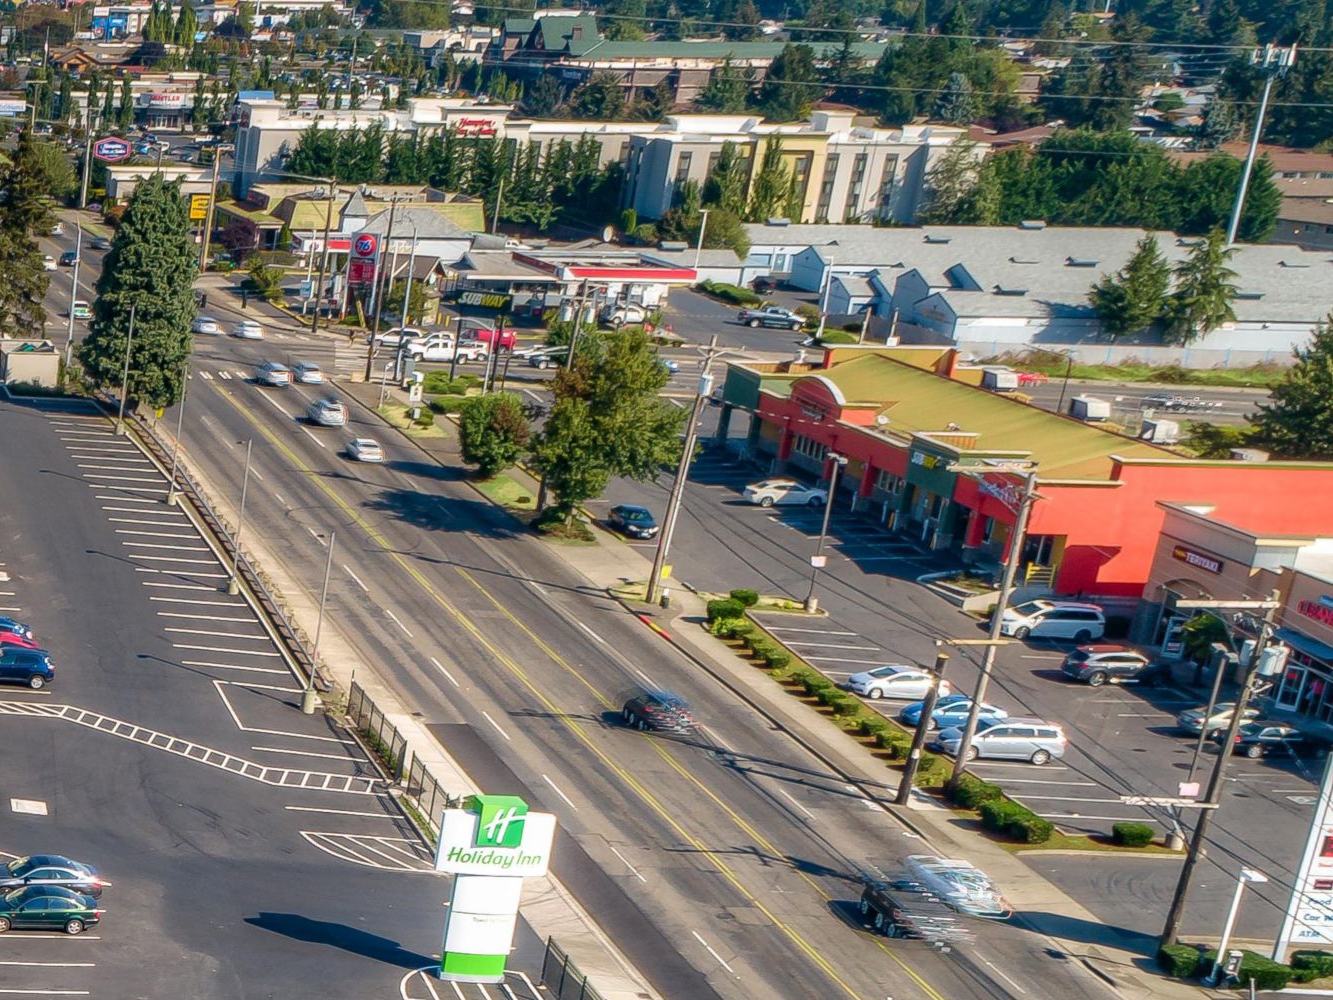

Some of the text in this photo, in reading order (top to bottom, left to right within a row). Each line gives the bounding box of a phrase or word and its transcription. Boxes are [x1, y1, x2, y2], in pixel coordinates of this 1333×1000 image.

[357, 240, 372, 251] 76
[458, 291, 508, 308] SUBWAY
[447, 847, 542, 869] Holiday Inn
